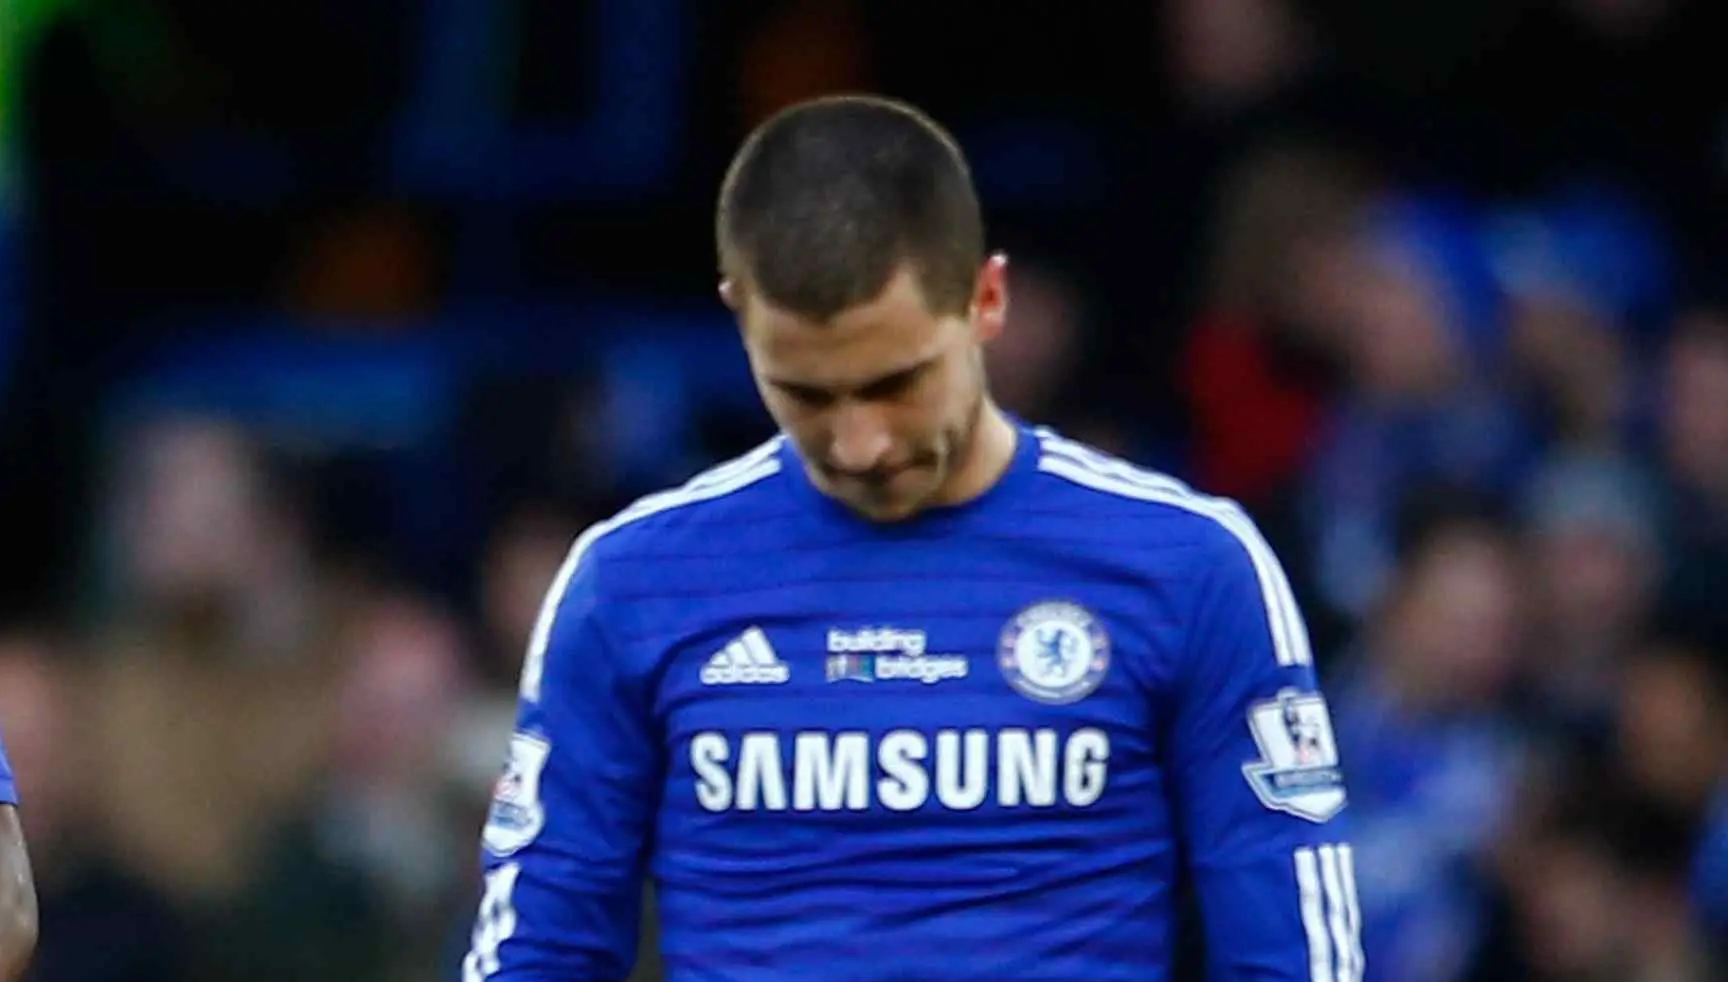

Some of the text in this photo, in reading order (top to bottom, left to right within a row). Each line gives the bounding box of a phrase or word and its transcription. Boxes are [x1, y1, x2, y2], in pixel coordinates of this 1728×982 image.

[827, 627, 926, 656] building
[699, 660, 789, 684] adidas
[875, 655, 968, 683] bridges
[690, 728, 1110, 811] SAMSUNG
